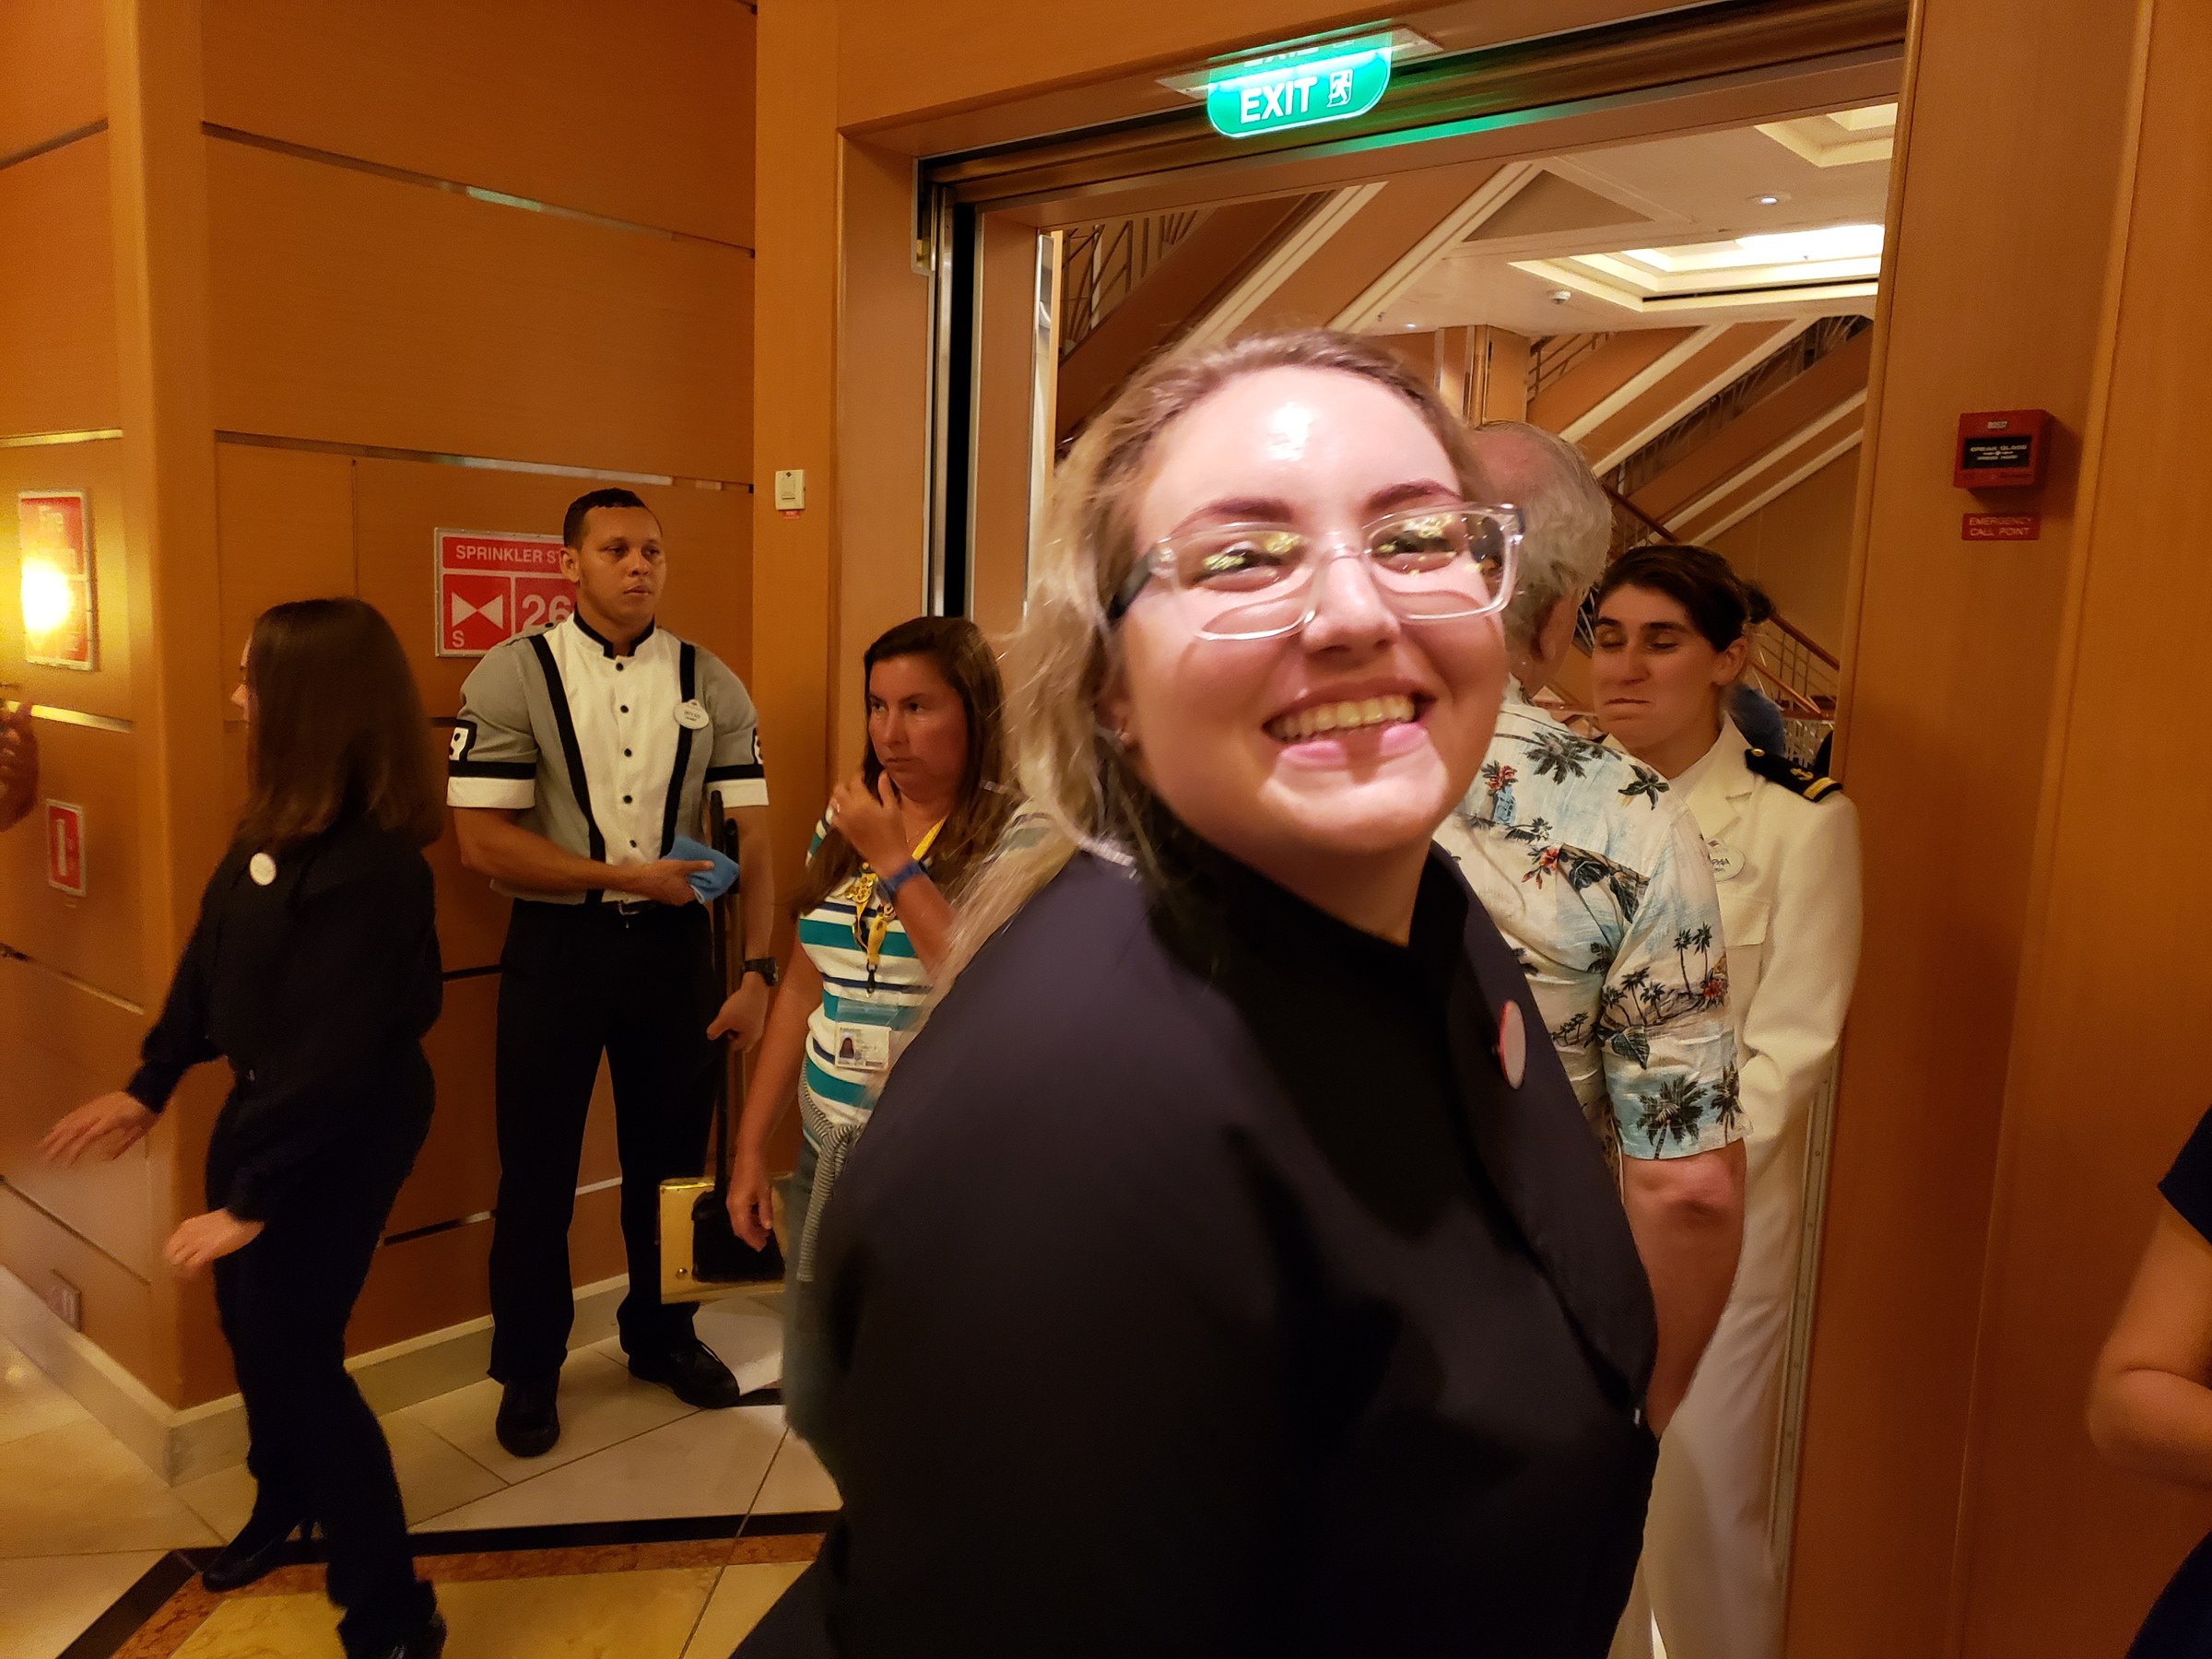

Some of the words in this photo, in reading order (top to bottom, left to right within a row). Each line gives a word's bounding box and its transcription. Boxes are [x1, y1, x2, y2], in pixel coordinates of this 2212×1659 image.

[1240, 76, 1318, 124] EXIT
[1969, 517, 2032, 526] EMERGENCY
[1970, 527, 1995, 536] CALL
[1998, 527, 2030, 536] POINT
[455, 545, 543, 563] SPRINKLER
[522, 594, 572, 629] 26
[452, 629, 465, 649] S
